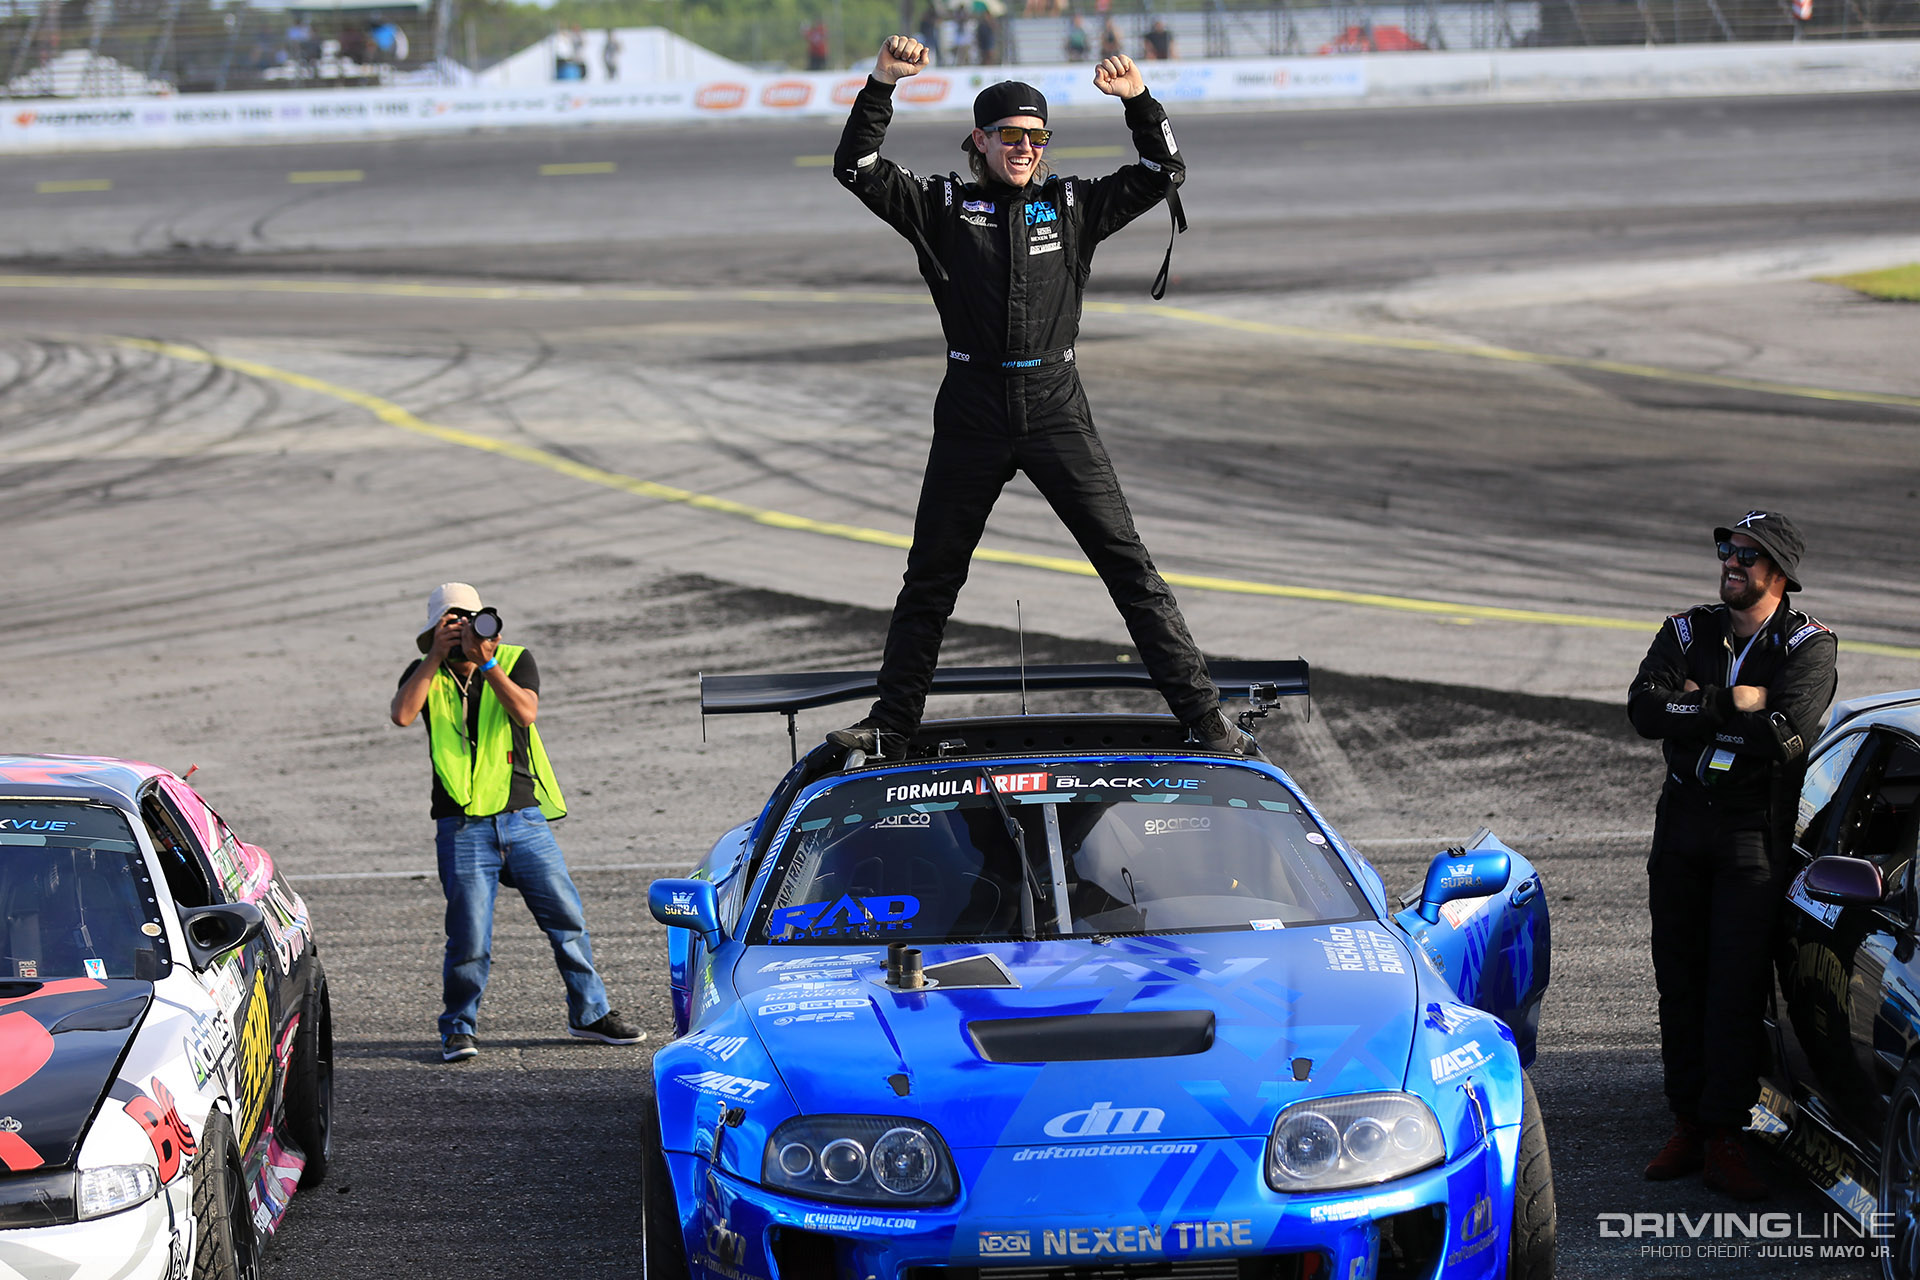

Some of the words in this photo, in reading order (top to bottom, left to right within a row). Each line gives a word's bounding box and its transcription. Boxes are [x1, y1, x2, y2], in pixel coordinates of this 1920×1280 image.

[1025, 201, 1052, 215] RAD
[1026, 209, 1057, 226] DAN
[1677, 617, 1690, 643] sparco
[1789, 625, 1816, 646] sparco
[886, 780, 974, 802] FORMULA
[1056, 778, 1201, 789] BLACKVUE
[1145, 817, 1211, 835] sparco
[1441, 877, 1483, 888] SUPRA
[664, 904, 699, 917] SUPRA
[771, 894, 920, 936] RAD
[767, 922, 913, 945] INDUSTRIES
[1329, 926, 1365, 971] RICHARD
[1368, 930, 1405, 974] BURKETT
[1043, 1101, 1166, 1138] dm
[1012, 1143, 1198, 1162] driftmotion.com
[1043, 1223, 1162, 1255] NEXEN
[1171, 1219, 1252, 1249] TIRE
